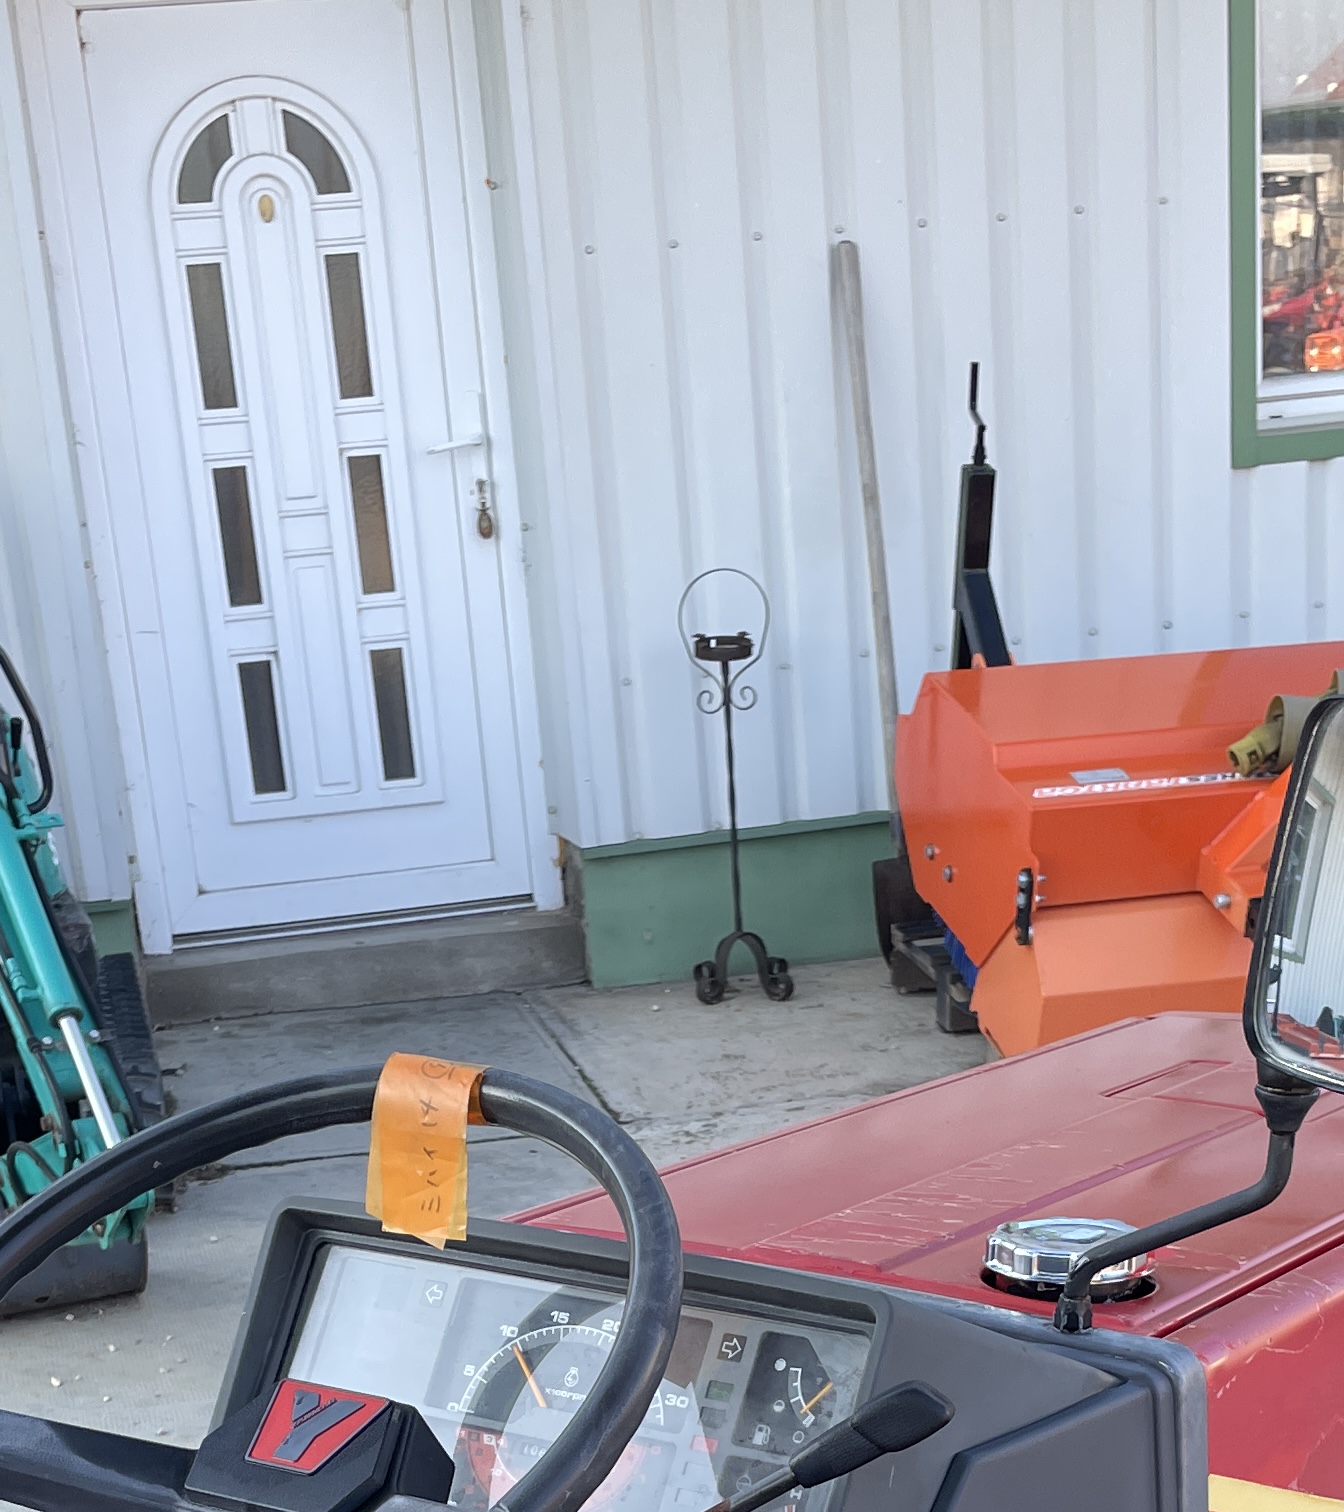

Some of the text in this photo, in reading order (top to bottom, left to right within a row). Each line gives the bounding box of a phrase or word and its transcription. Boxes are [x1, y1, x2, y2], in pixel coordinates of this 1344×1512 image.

[550, 1311, 570, 1324] 15
[499, 1325, 519, 1338] 10
[464, 1365, 475, 1376] 5
[665, 1393, 689, 1408] 30
[790, 1489, 803, 1500] H
